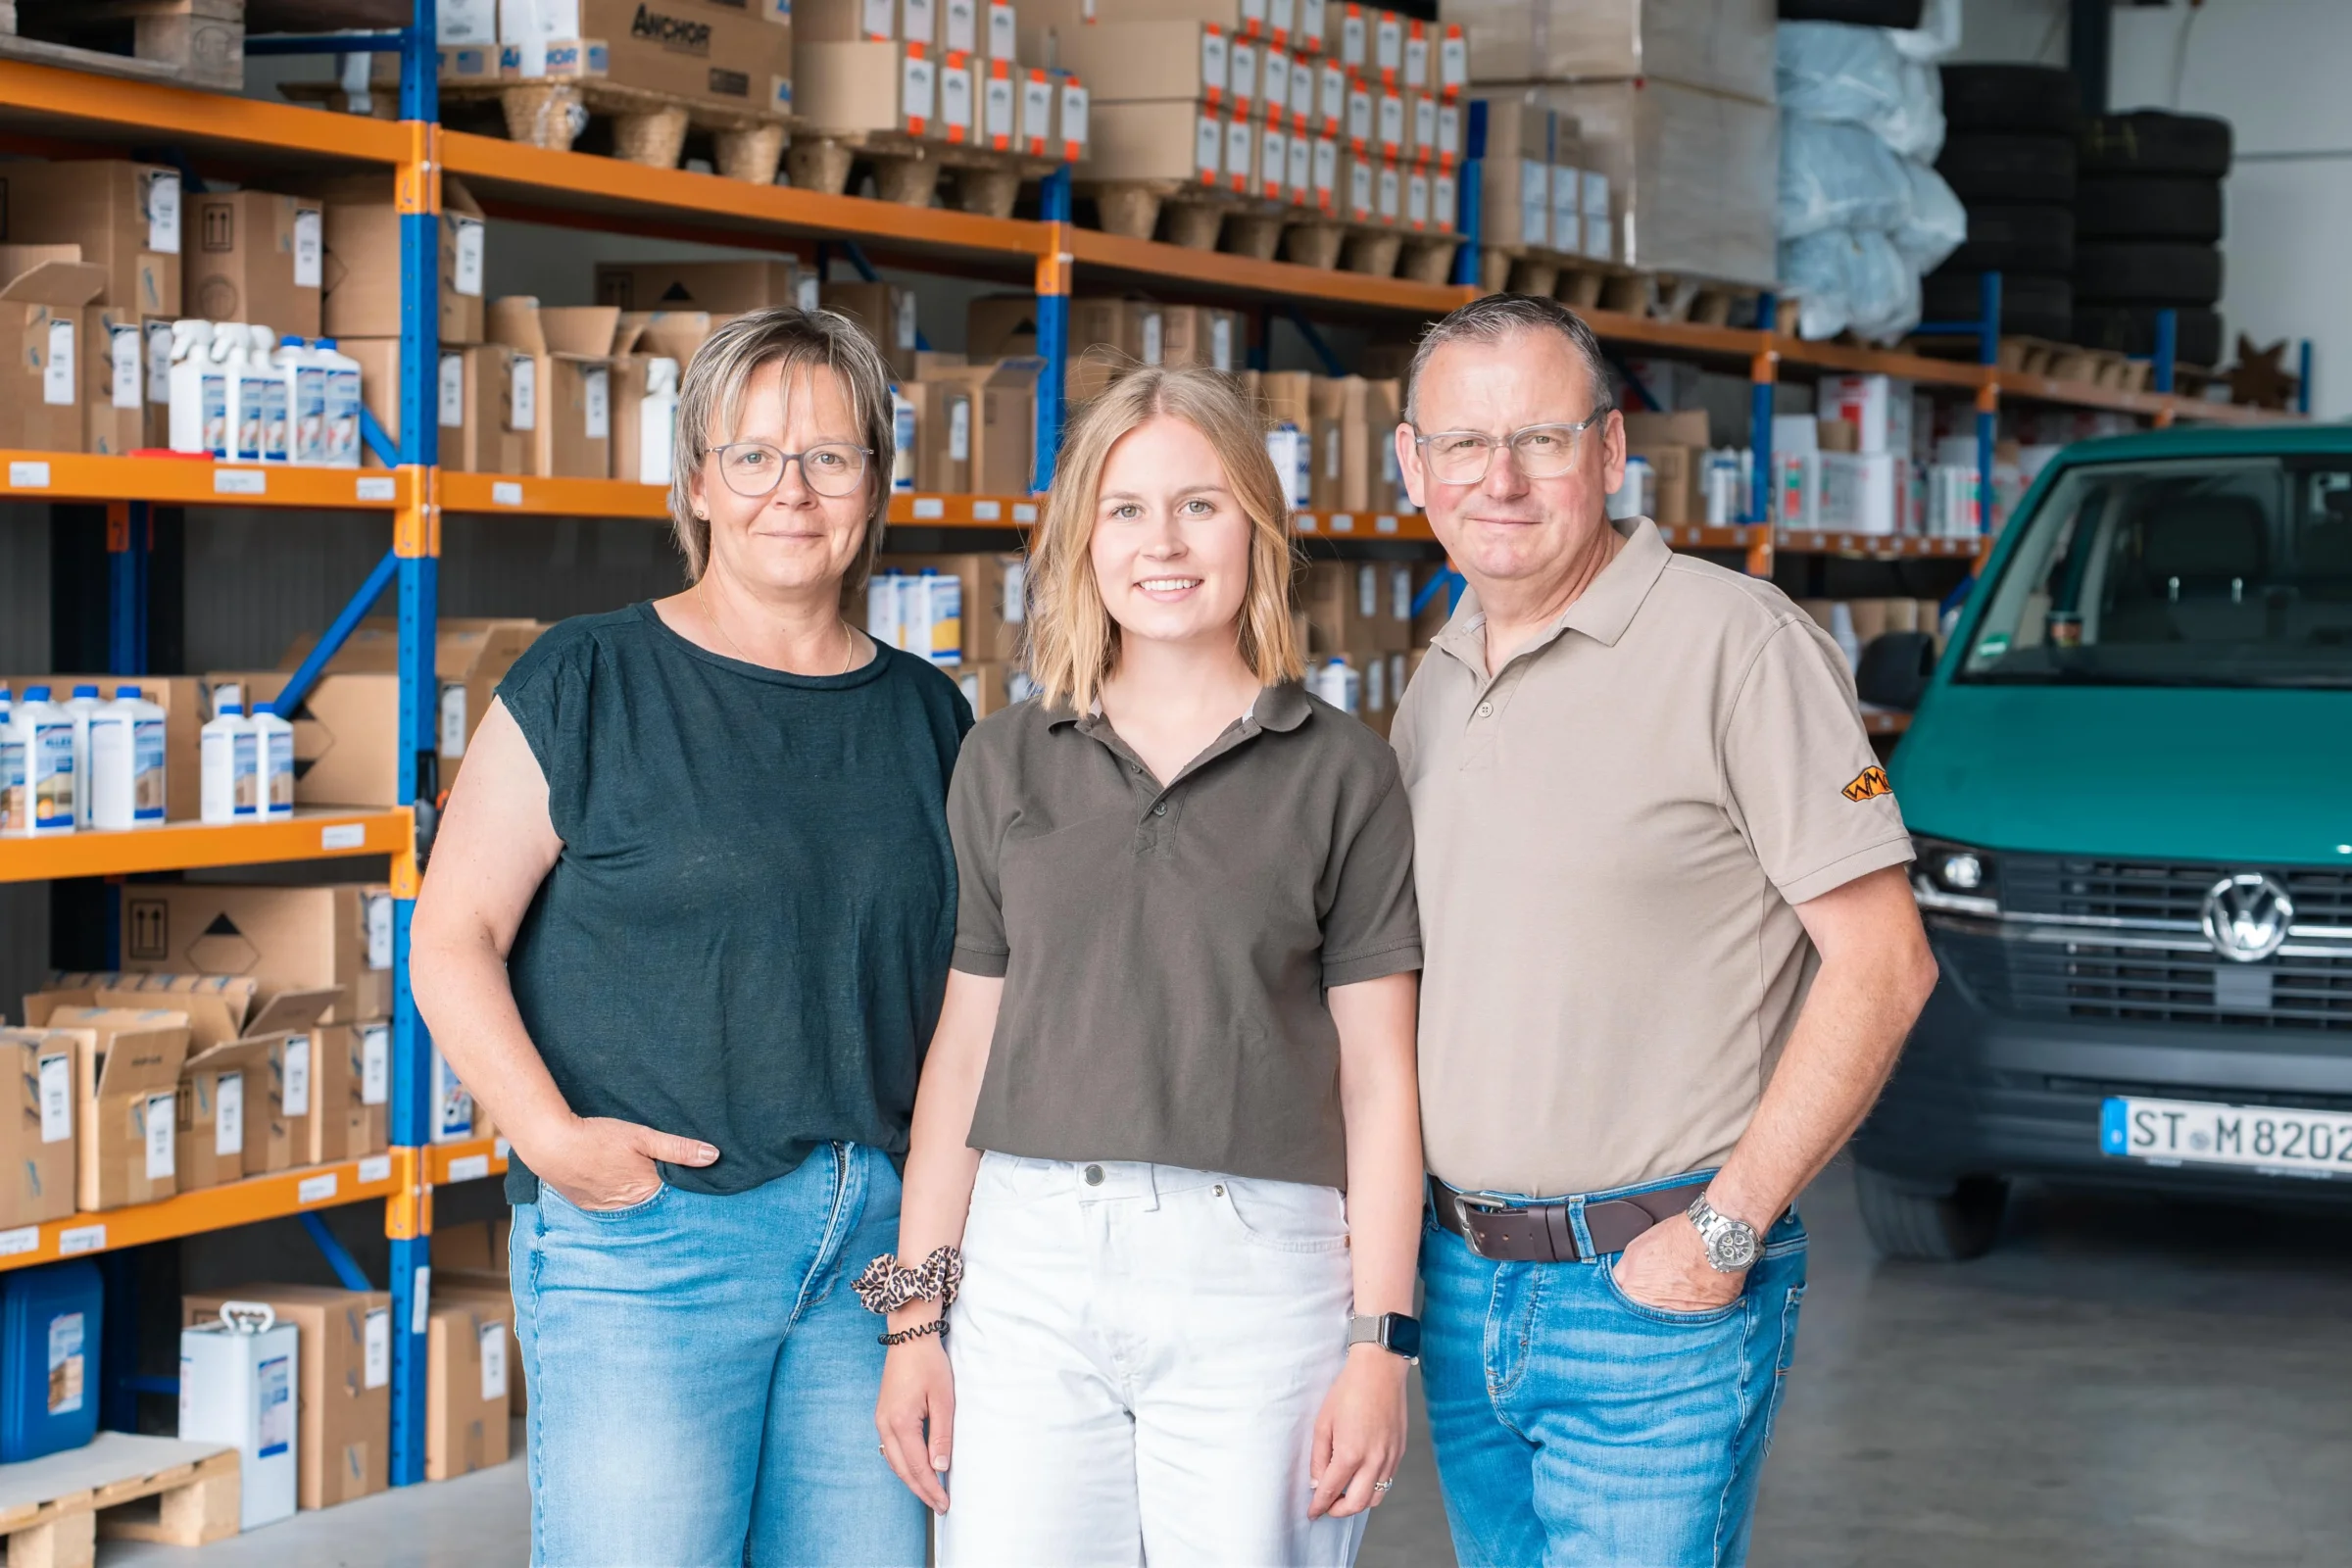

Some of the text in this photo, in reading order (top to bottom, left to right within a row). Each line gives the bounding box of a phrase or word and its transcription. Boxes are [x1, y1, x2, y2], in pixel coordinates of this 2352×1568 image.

[631, 3, 711, 45] ANCHOR
[2203, 873, 2293, 961] VW
[2132, 1110, 2352, 1164] ST M 8202
